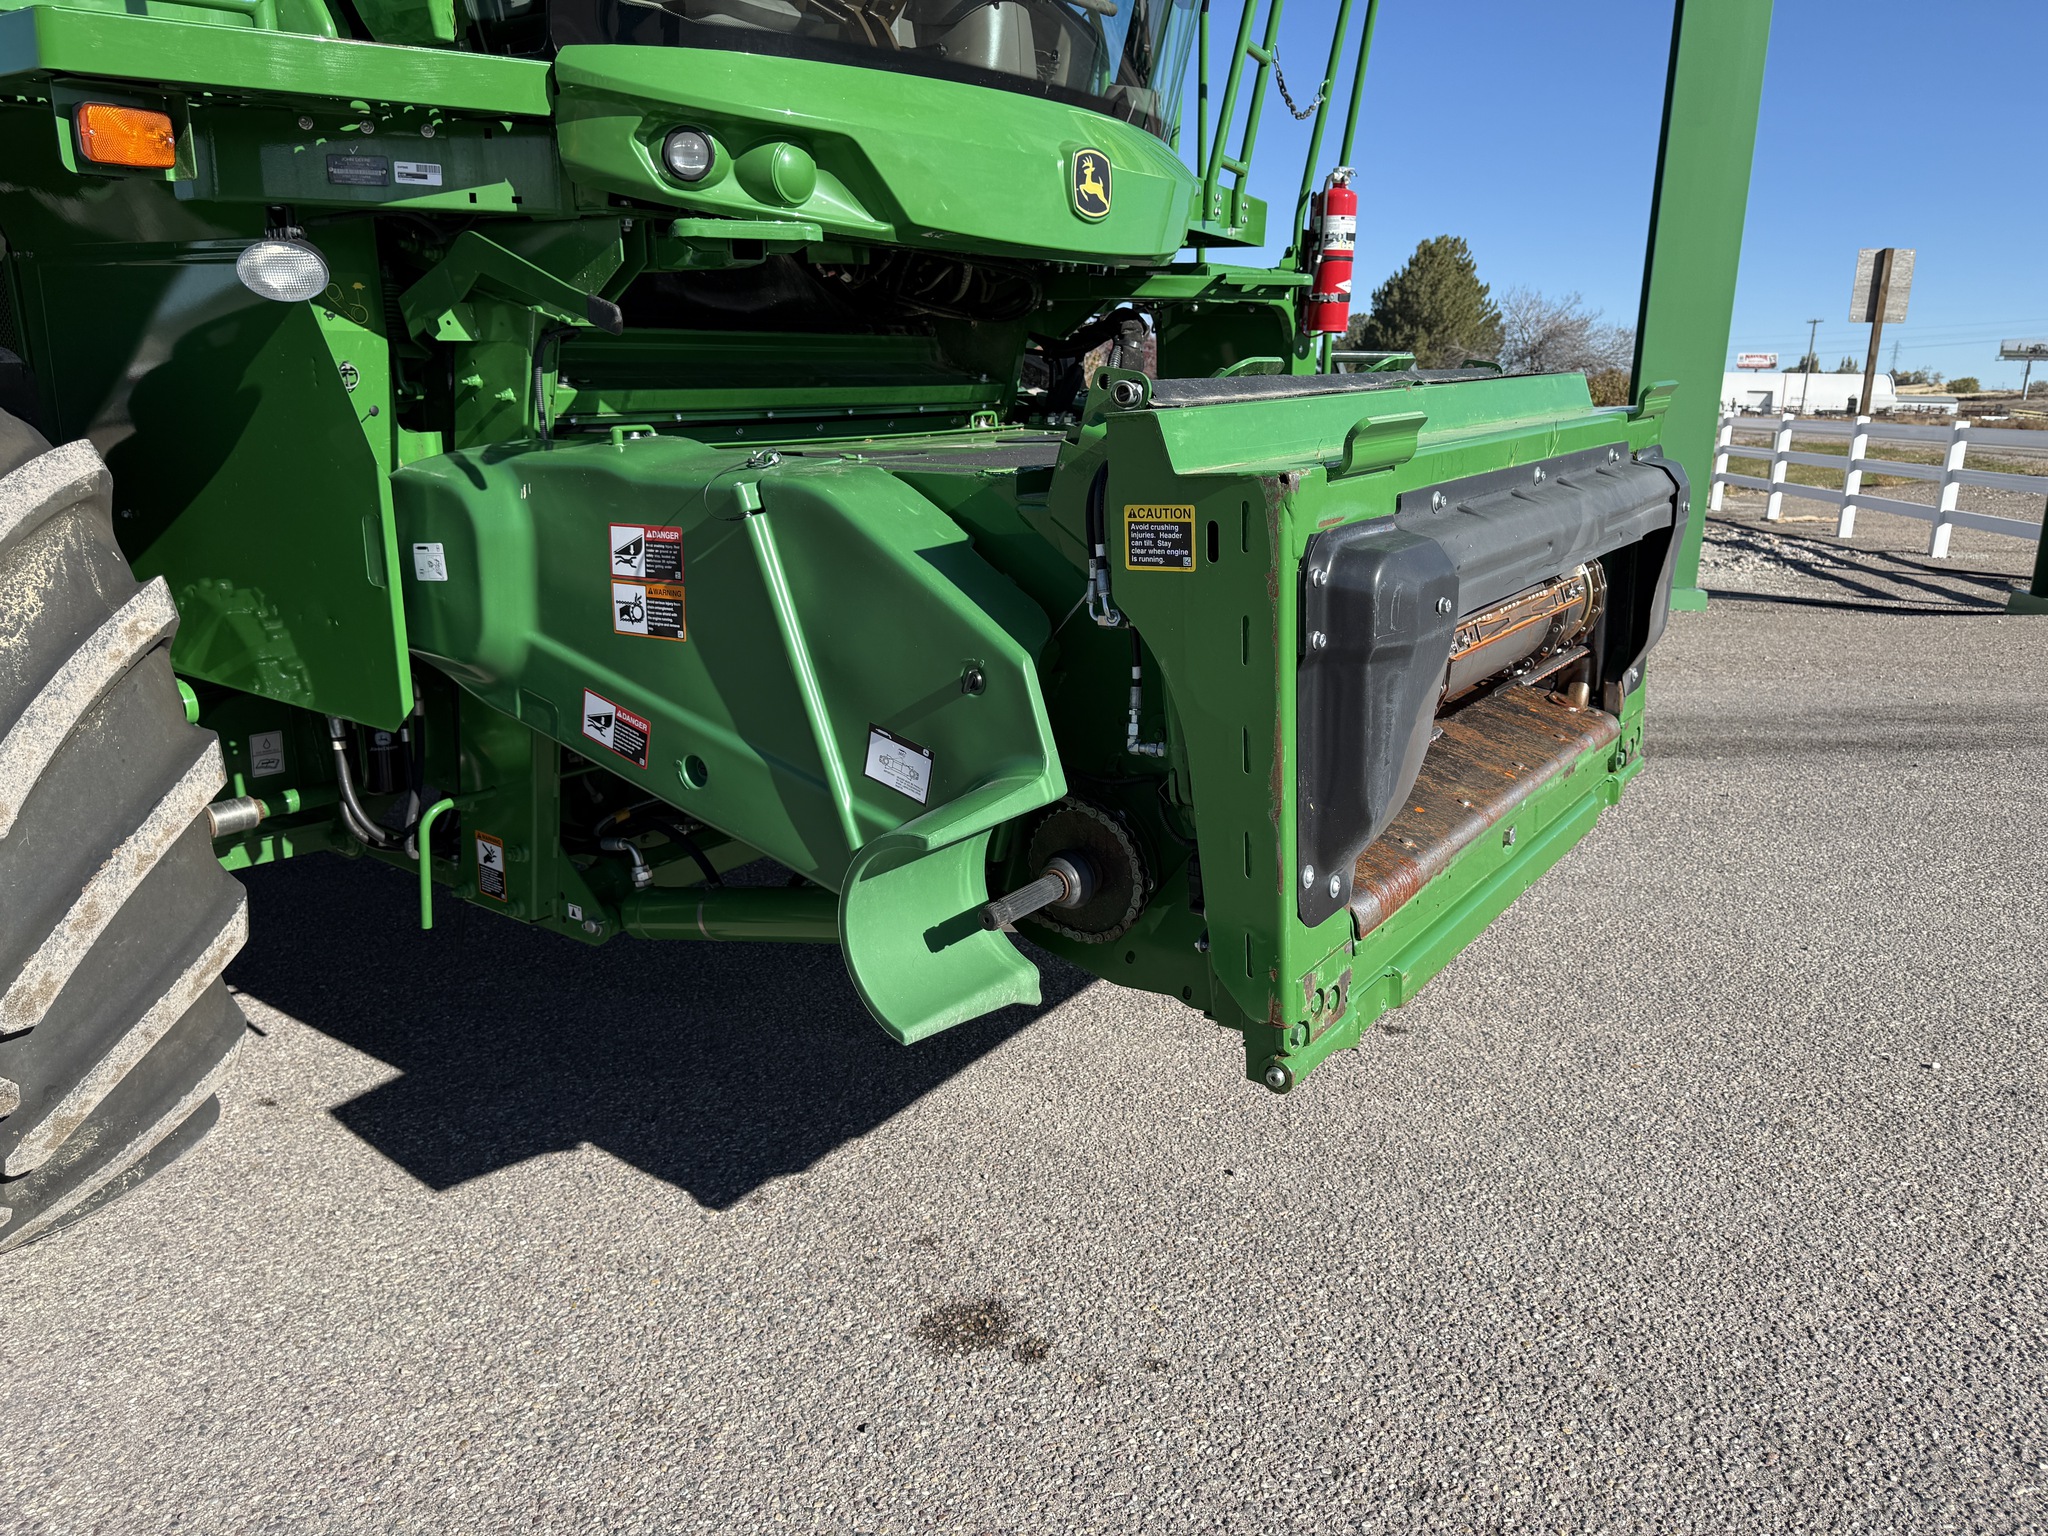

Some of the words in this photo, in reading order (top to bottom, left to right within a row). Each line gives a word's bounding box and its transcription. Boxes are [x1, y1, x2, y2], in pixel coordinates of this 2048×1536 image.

[1137, 508, 1190, 519] CAUTION
[1150, 524, 1179, 532] crushing
[652, 530, 679, 540] DANGER
[1131, 531, 1156, 539] injuries.
[1157, 540, 1172, 548] Stay
[1139, 556, 1165, 565] running.
[653, 588, 681, 597] WARNING
[622, 713, 648, 731] DANGER
